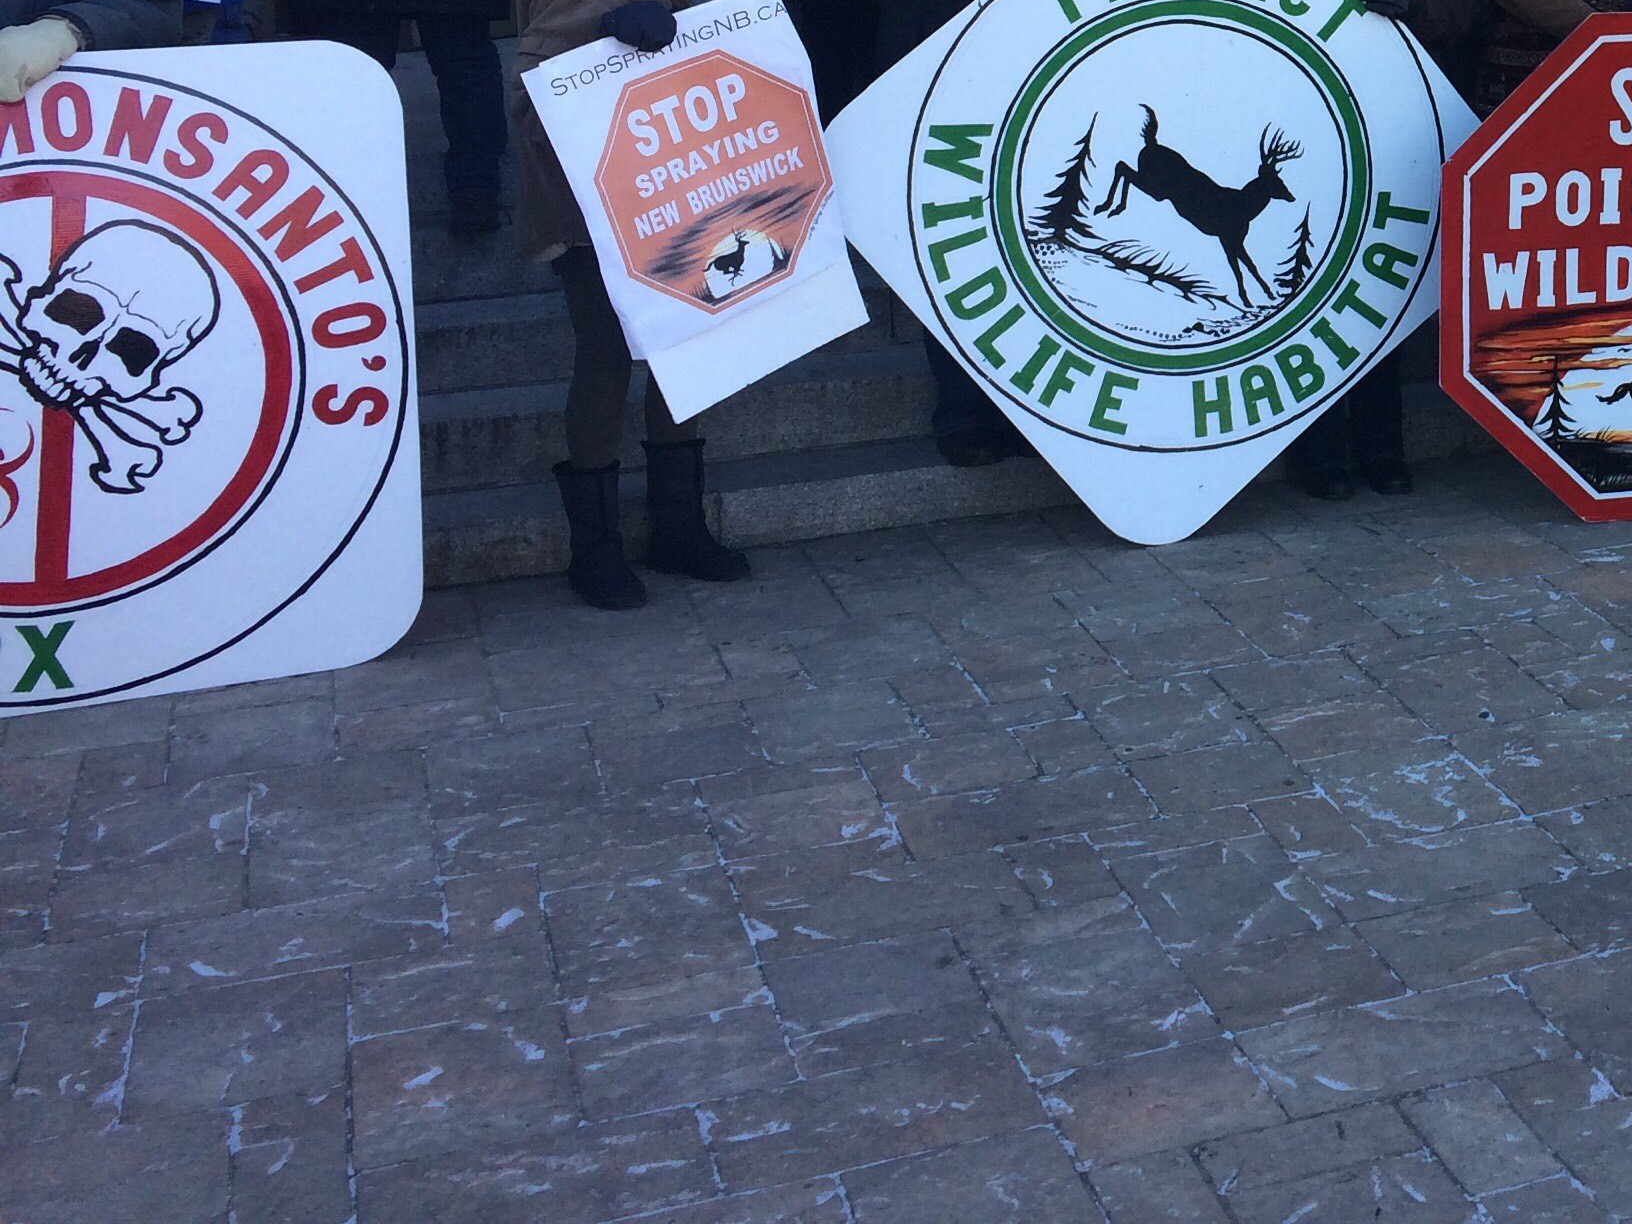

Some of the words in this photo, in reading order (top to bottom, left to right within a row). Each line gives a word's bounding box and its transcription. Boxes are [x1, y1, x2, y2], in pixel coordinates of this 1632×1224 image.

[627, 73, 746, 157] STOP
[634, 119, 780, 198] SPRAYING
[633, 200, 681, 240] NEW
[686, 146, 804, 216] BRUNSWICK
[922, 123, 1140, 436] WILDLIFE
[1192, 191, 1434, 438] HABITAT
